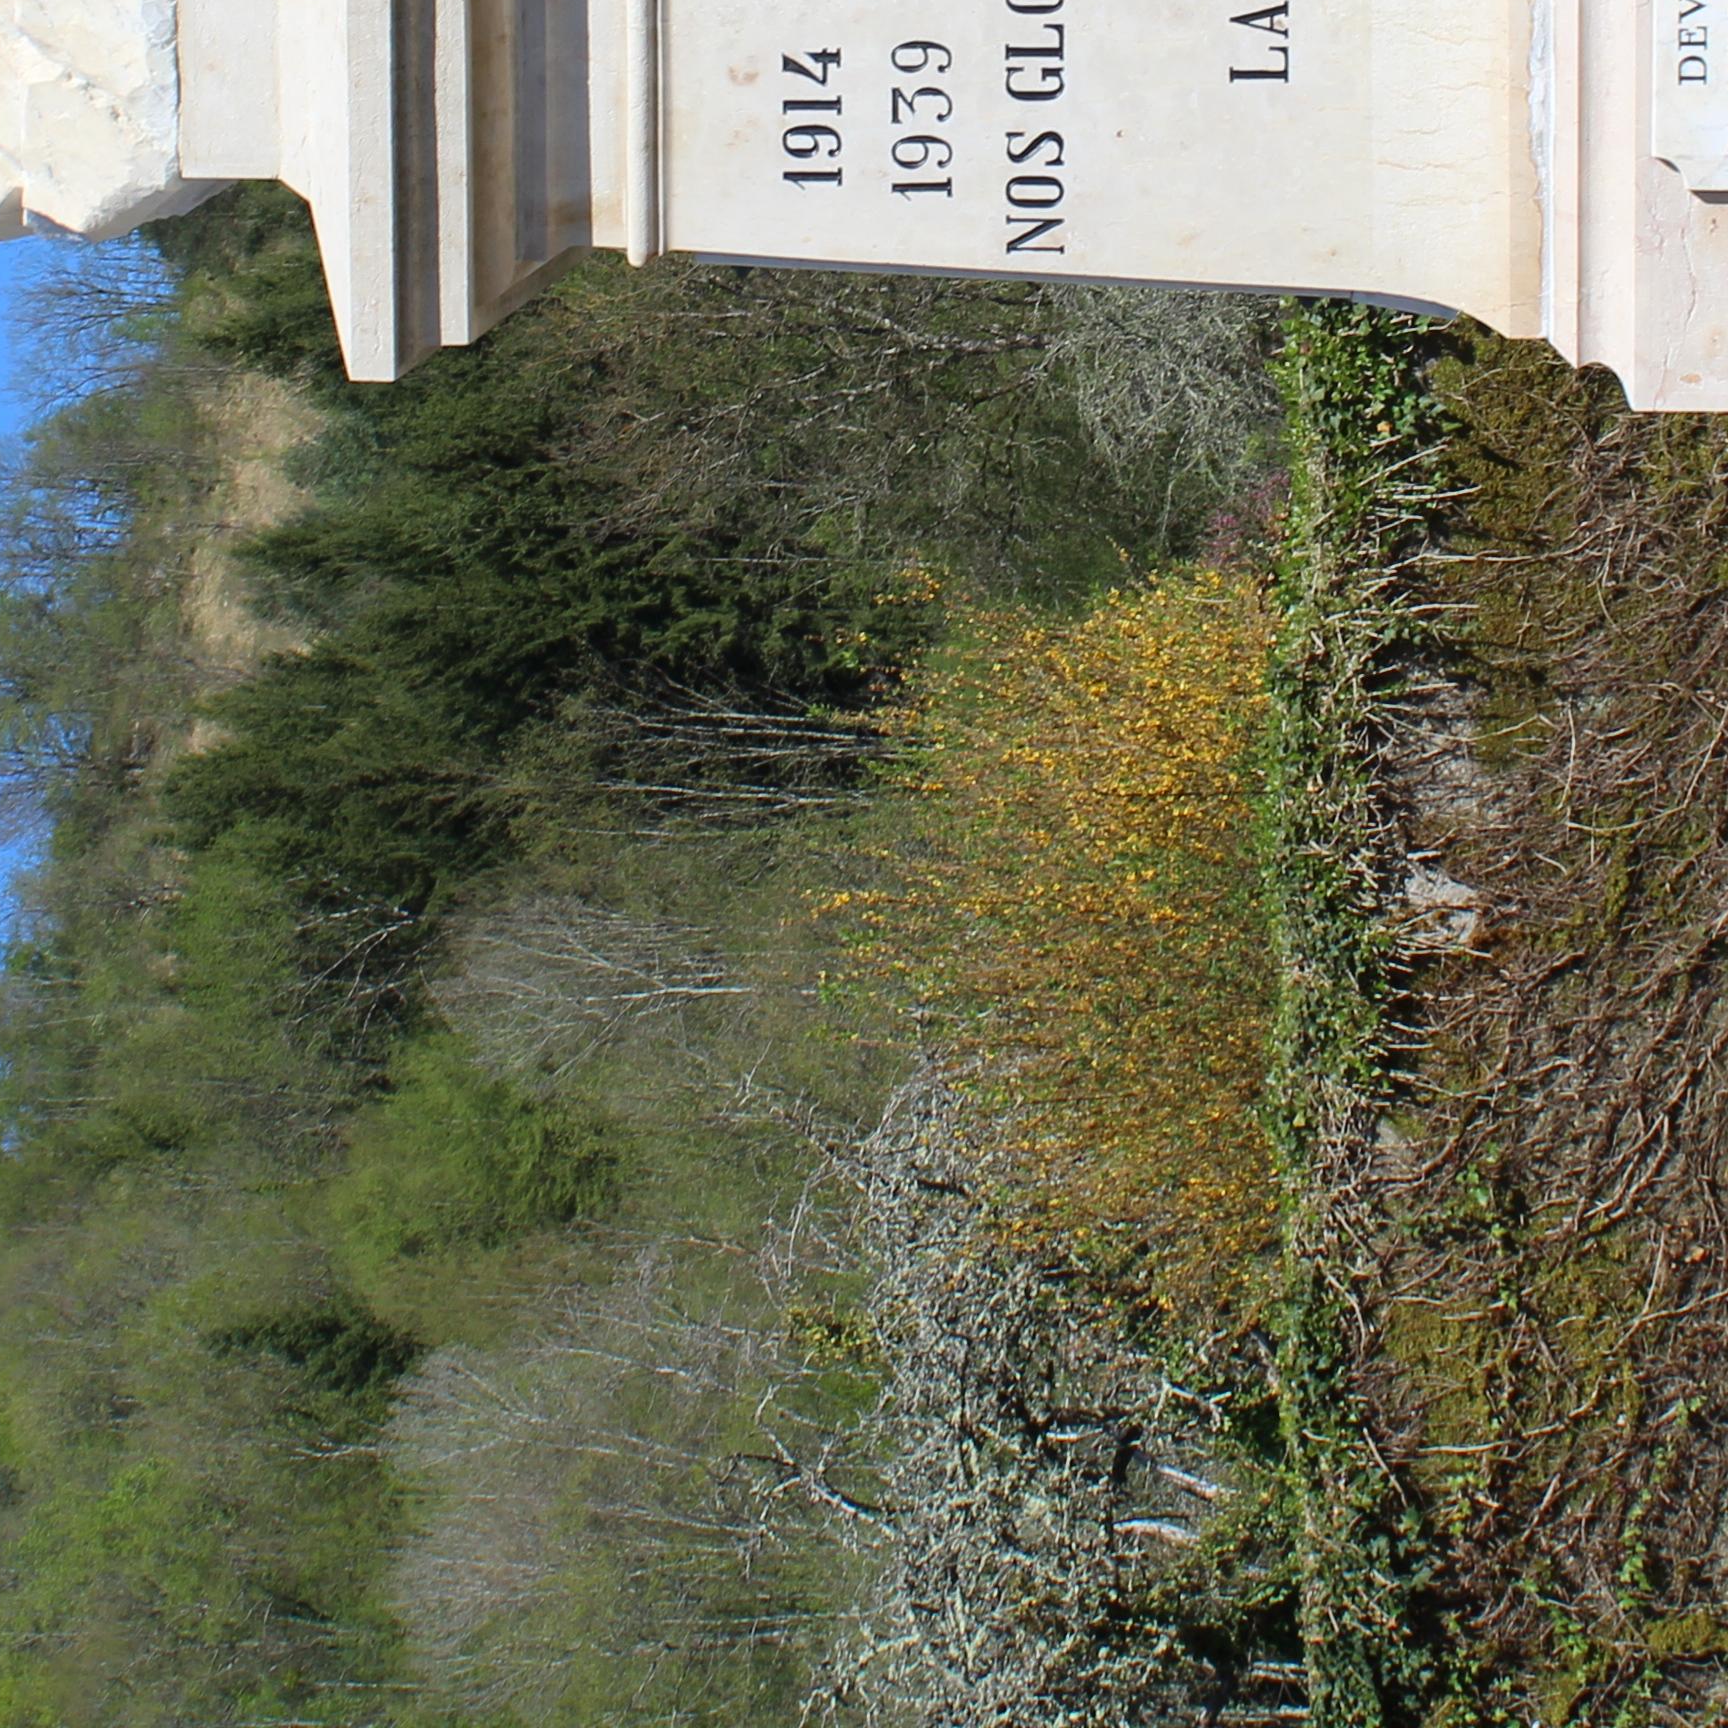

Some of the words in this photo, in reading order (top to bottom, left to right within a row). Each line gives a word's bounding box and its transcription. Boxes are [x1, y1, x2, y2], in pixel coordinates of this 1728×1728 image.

[1228, 0, 1290, 84] LA
[780, 48, 843, 188] 1914
[891, 40, 953, 199] 1939
[1004, 130, 1065, 255] NOS
